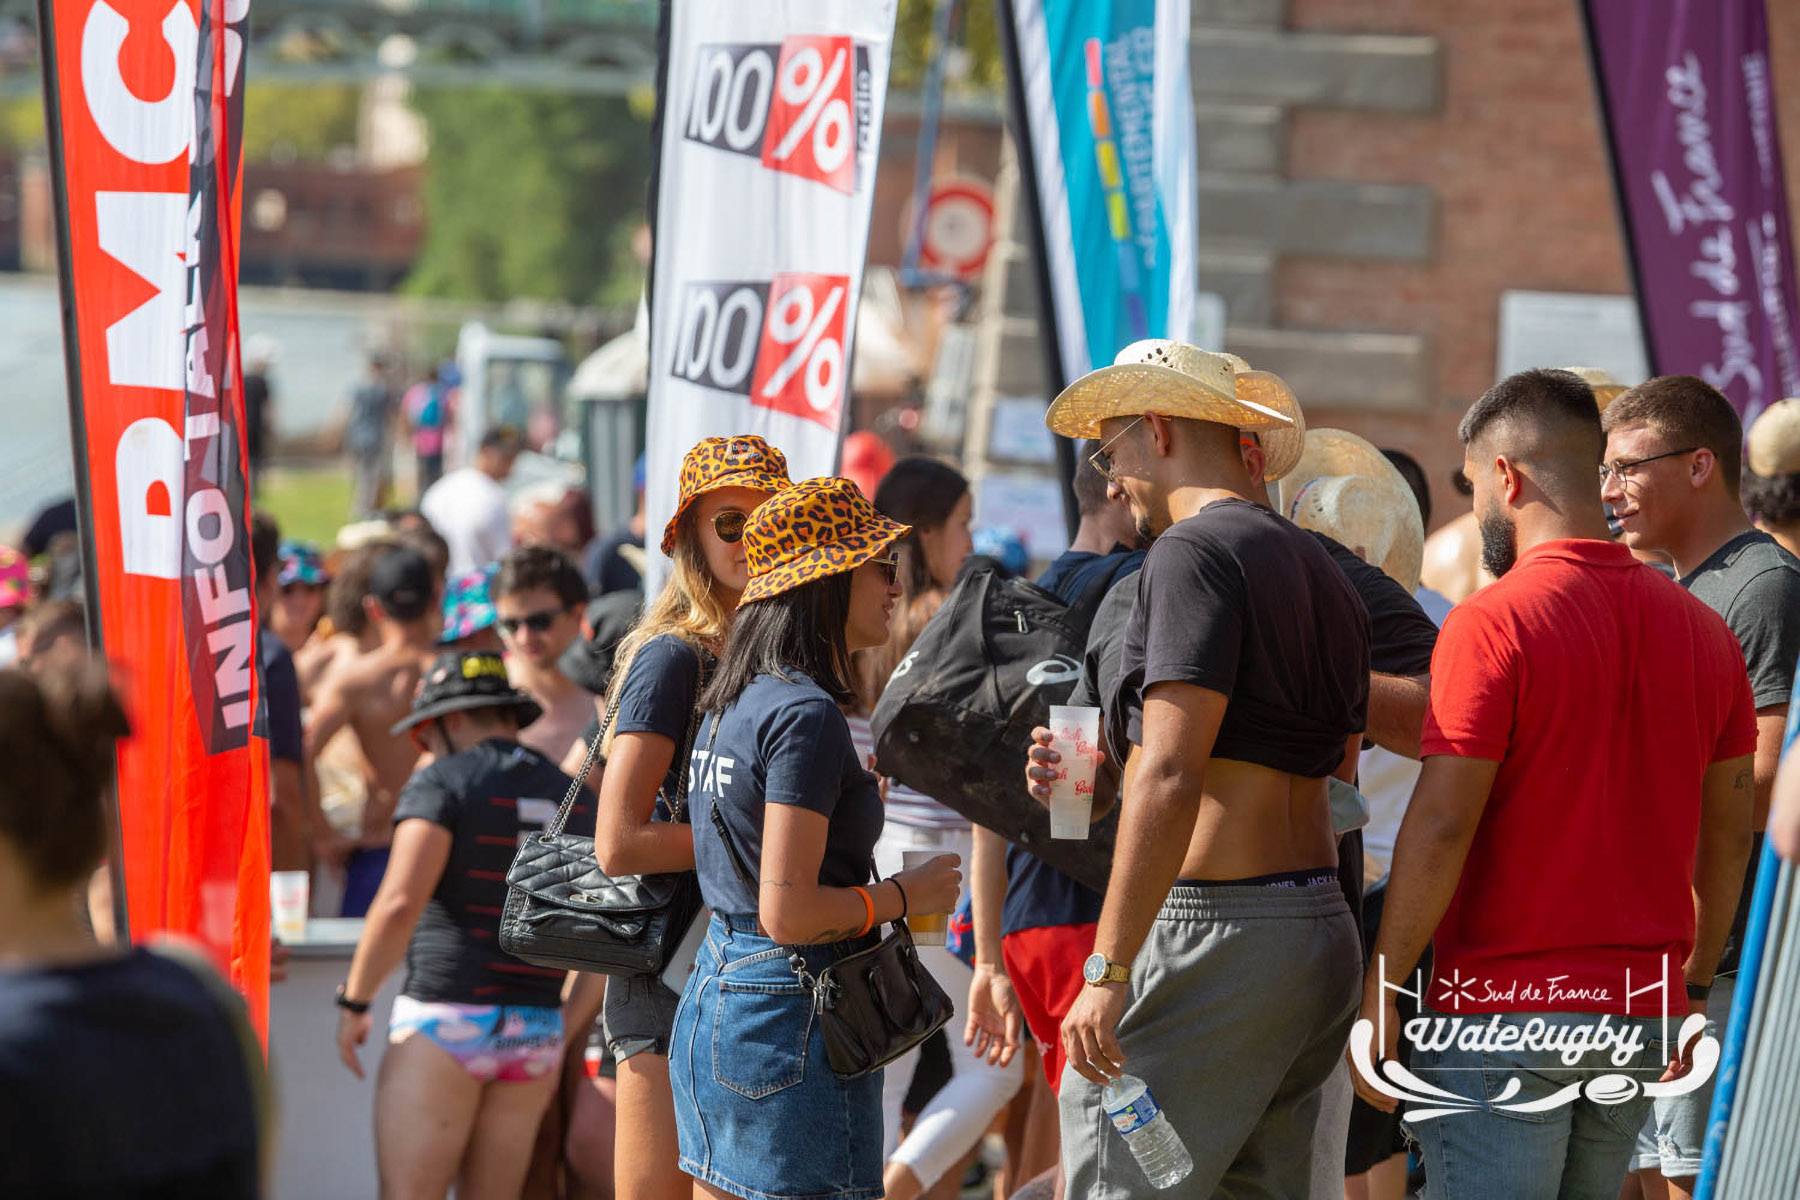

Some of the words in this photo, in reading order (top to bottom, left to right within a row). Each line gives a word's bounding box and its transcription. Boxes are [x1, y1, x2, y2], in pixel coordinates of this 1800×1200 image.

[688, 47, 853, 173] 100%
[1652, 50, 1735, 235] France
[82, 0, 198, 579] RMC
[1690, 226, 1740, 295] de
[674, 284, 843, 412] 100%
[186, 487, 251, 730] INFO
